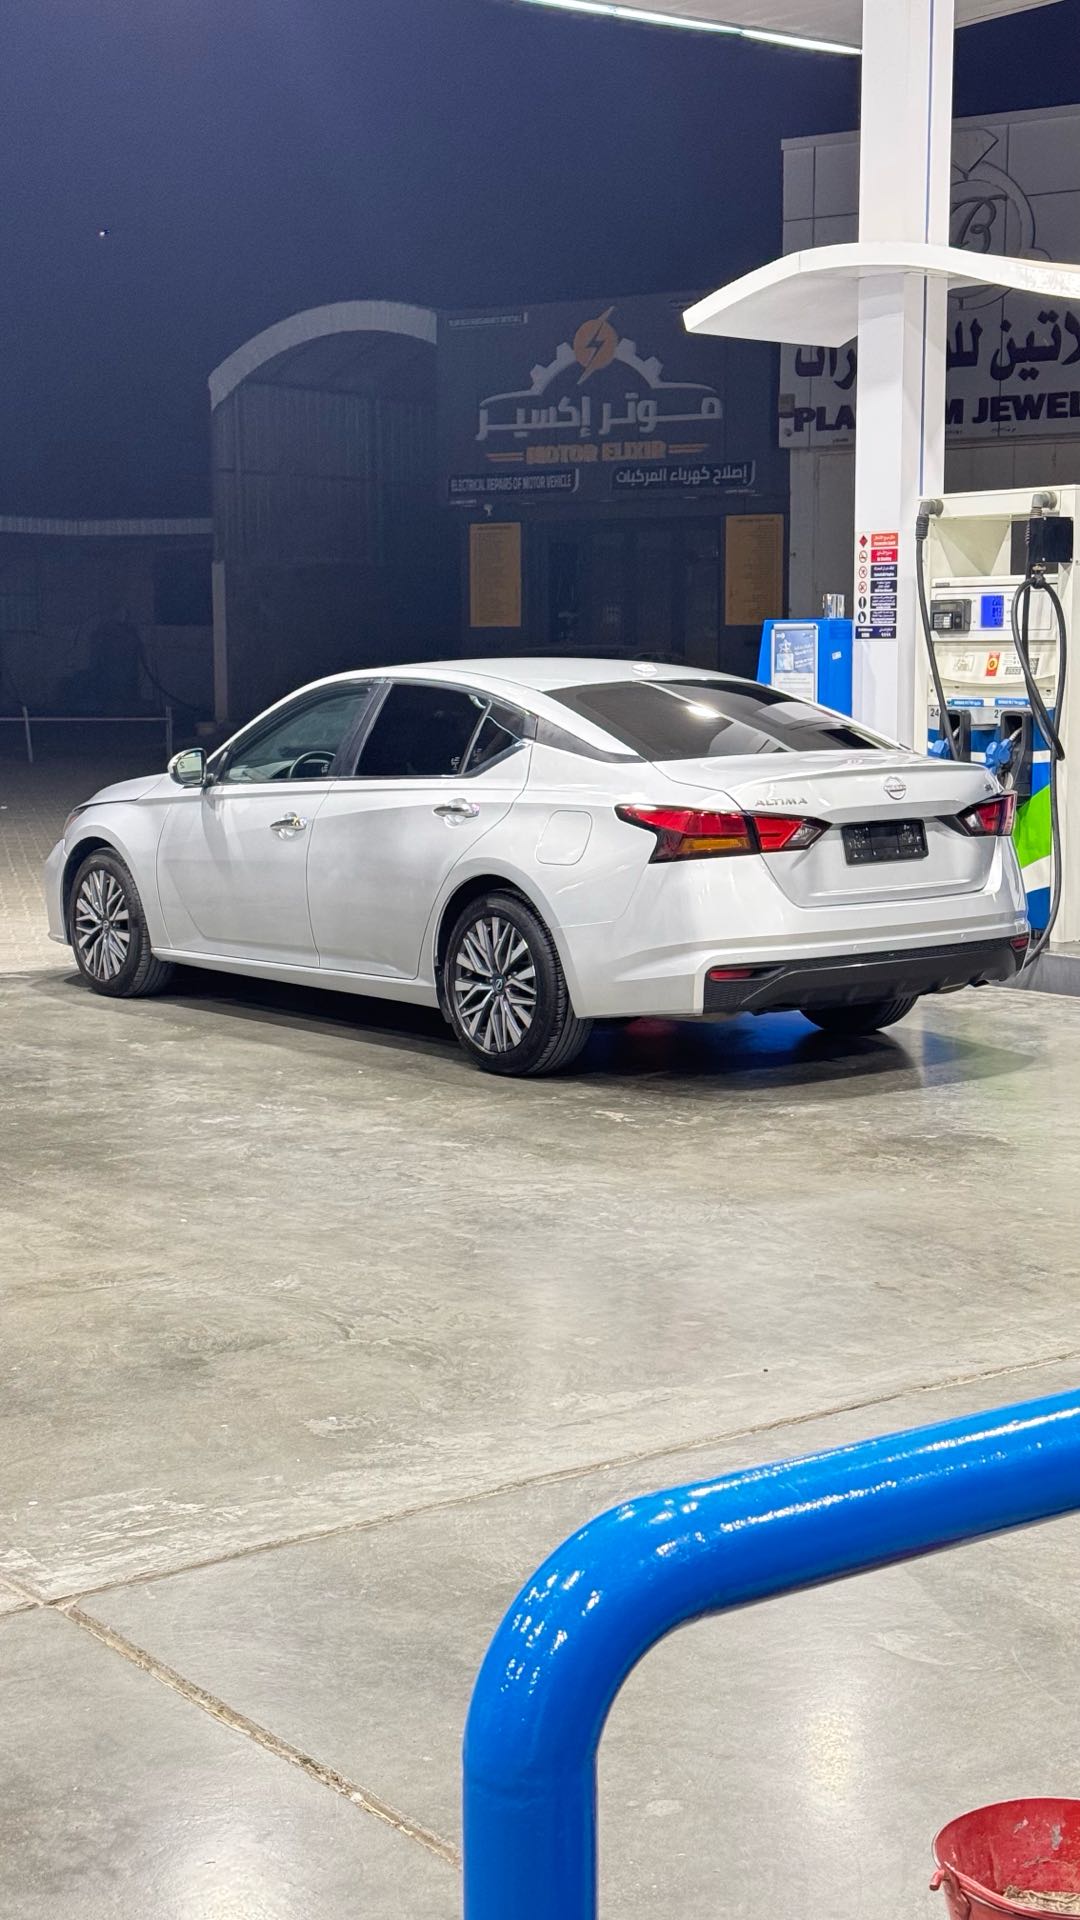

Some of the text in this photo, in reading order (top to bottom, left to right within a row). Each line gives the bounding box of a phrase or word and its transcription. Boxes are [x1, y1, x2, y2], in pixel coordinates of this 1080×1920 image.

[474, 396, 591, 440] إكسير
[523, 475, 546, 489] MOTOR
[547, 473, 572, 488] VEHICLE
[616, 464, 748, 487] إصلاح كهرباء المركبات
[754, 797, 809, 807] ALTIMA
